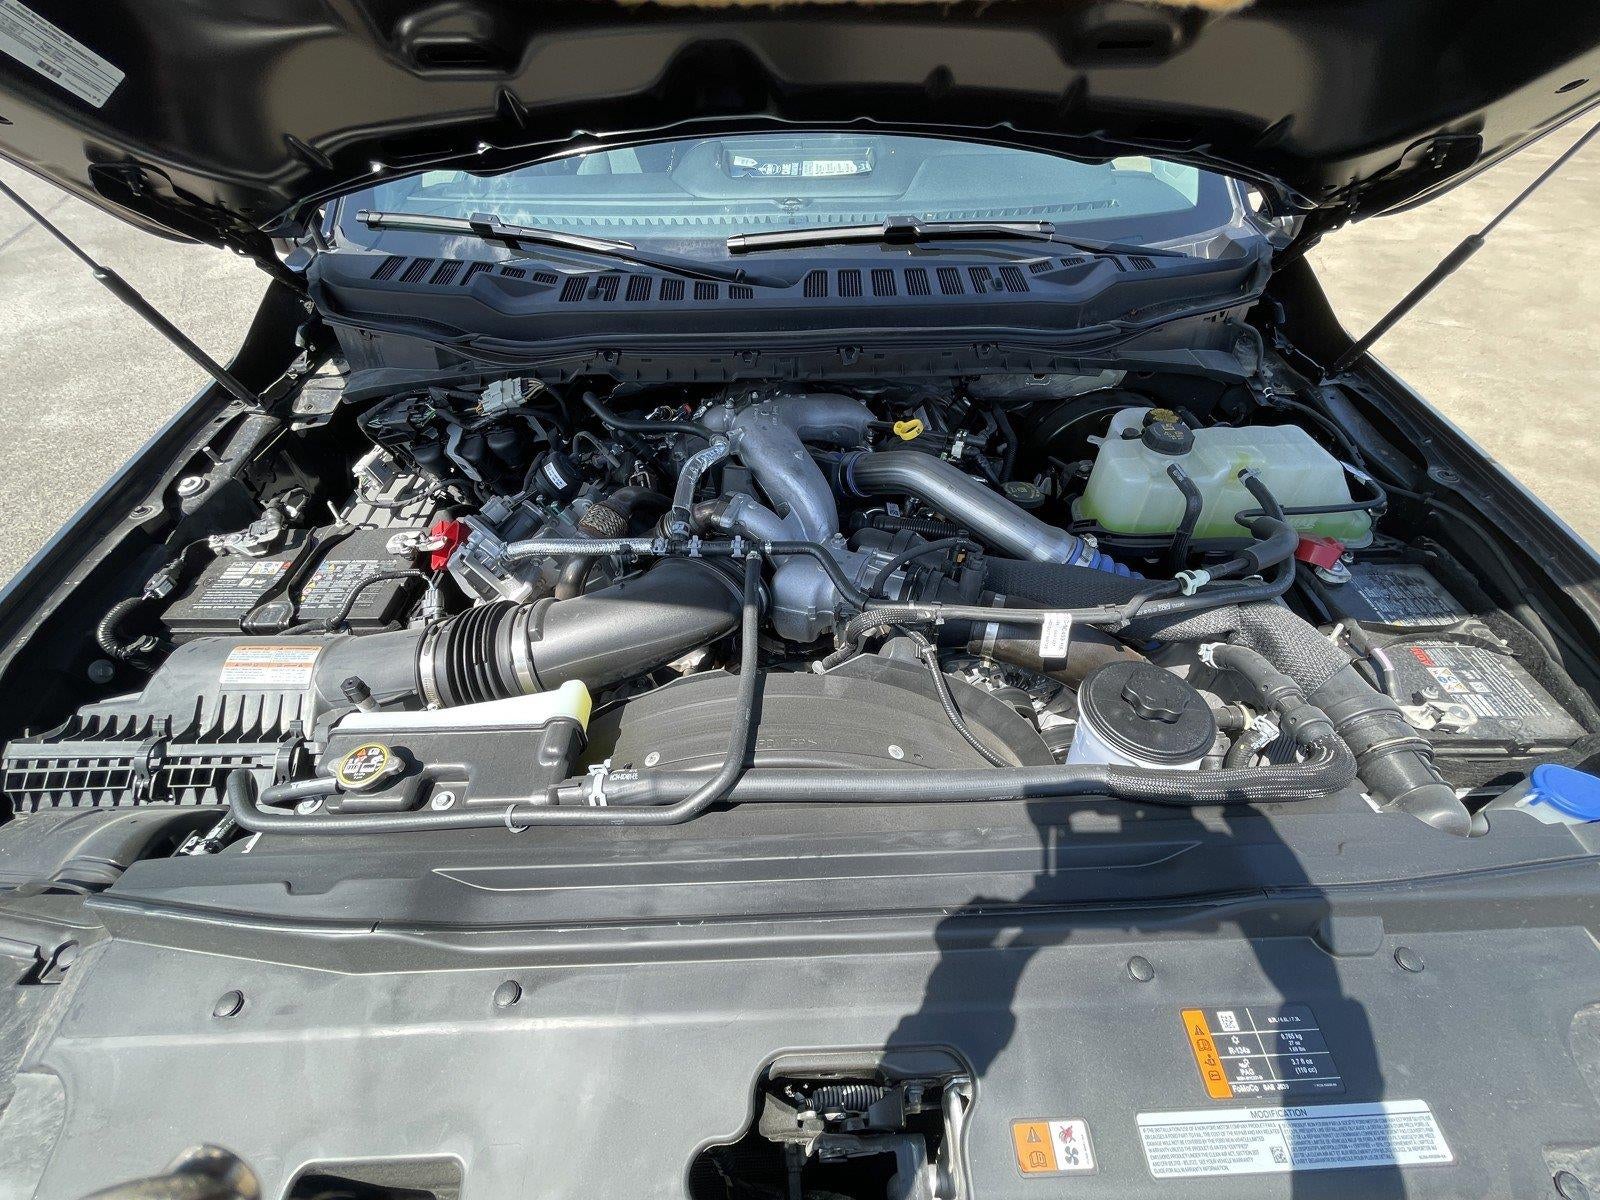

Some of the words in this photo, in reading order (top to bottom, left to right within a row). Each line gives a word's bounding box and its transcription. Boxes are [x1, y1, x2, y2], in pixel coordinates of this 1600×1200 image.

[1294, 1032, 1304, 1041] kg
[1294, 1066, 1308, 1075] (110
[1307, 1065, 1318, 1074] cc)
[1231, 1084, 1260, 1093] FoMoCo
[1249, 1108, 1308, 1119] MODIFICATION
